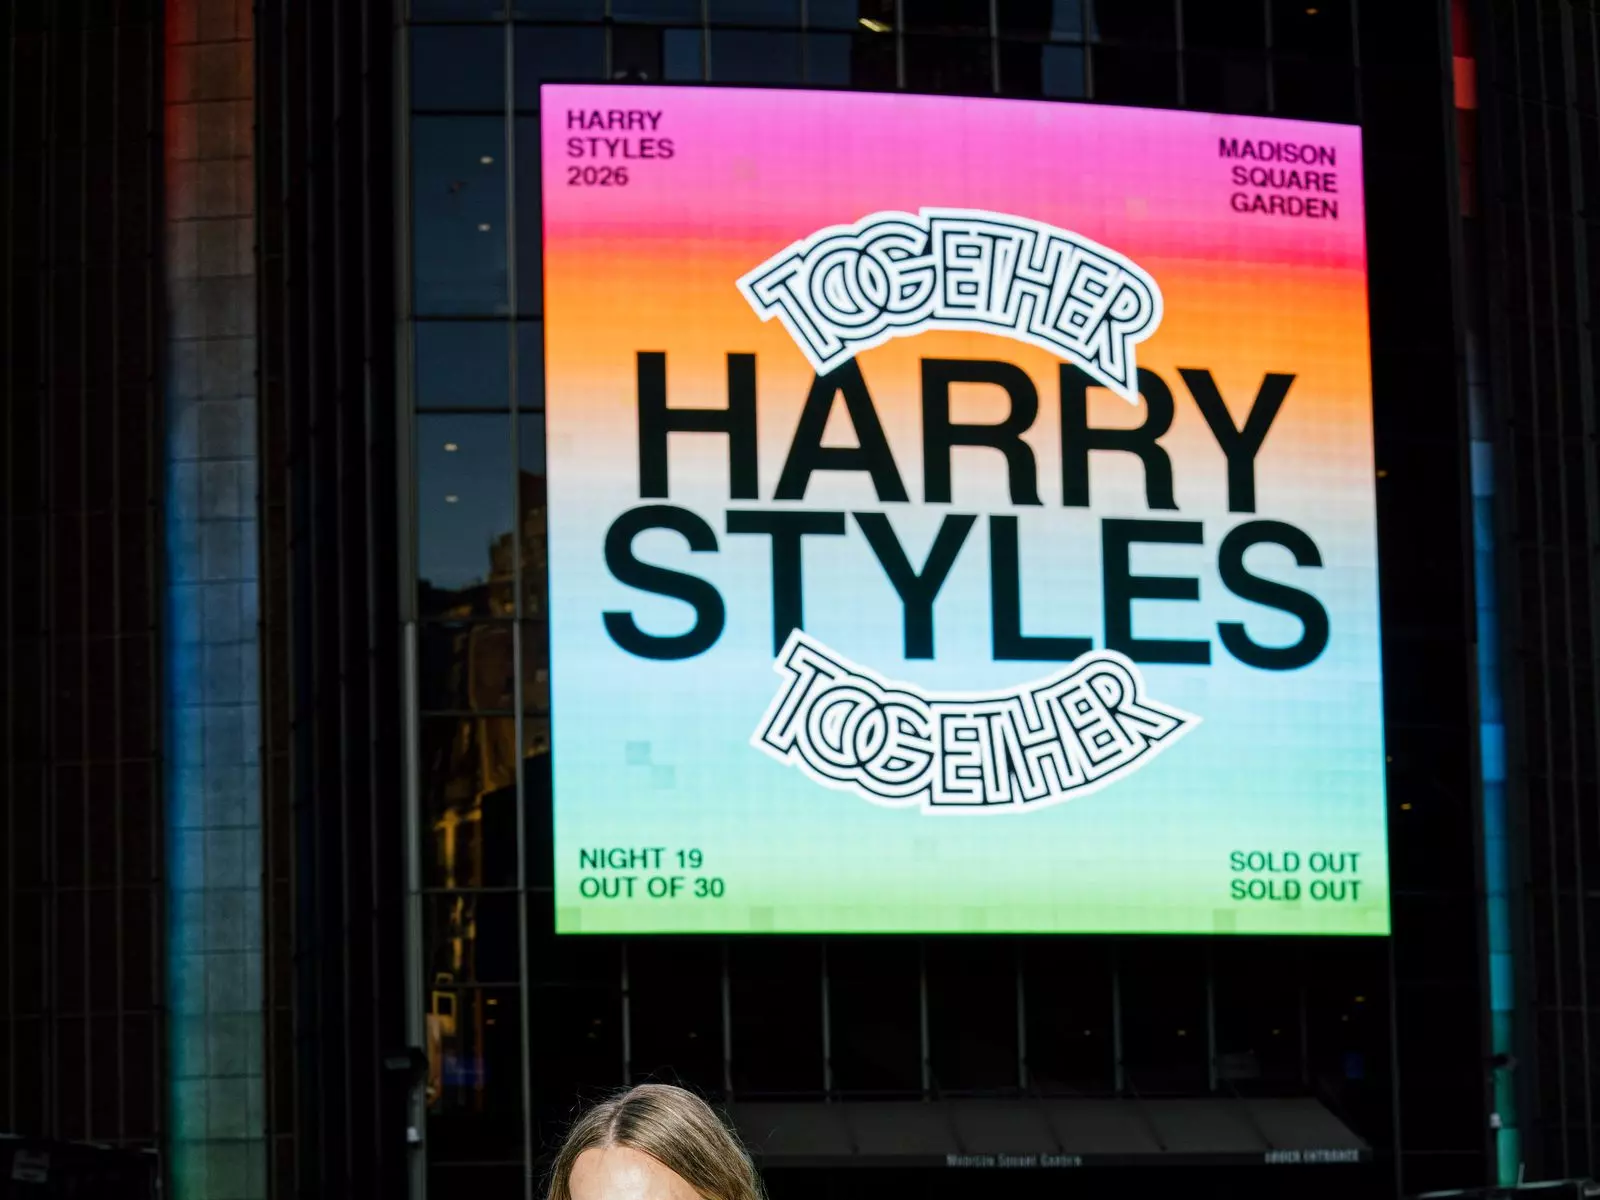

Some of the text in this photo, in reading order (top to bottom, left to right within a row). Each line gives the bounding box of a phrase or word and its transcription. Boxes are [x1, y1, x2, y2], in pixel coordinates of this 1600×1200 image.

[567, 109, 662, 131] HARRY
[566, 137, 675, 160] STYLES
[1219, 137, 1336, 167] MADISON
[567, 165, 629, 187] 2026
[1231, 165, 1338, 193] SQUARE
[1230, 192, 1338, 220] GARDEN
[739, 209, 1162, 402] TOGETHER
[635, 351, 1297, 513] HARRY
[601, 505, 1331, 672] STYLES
[753, 632, 1198, 812] TOGETHER
[579, 848, 703, 869] NIGHT 19
[1230, 850, 1360, 873] SOLD OUT
[579, 877, 725, 898] OUT OF 30
[1230, 879, 1361, 901] SOLD OUT
